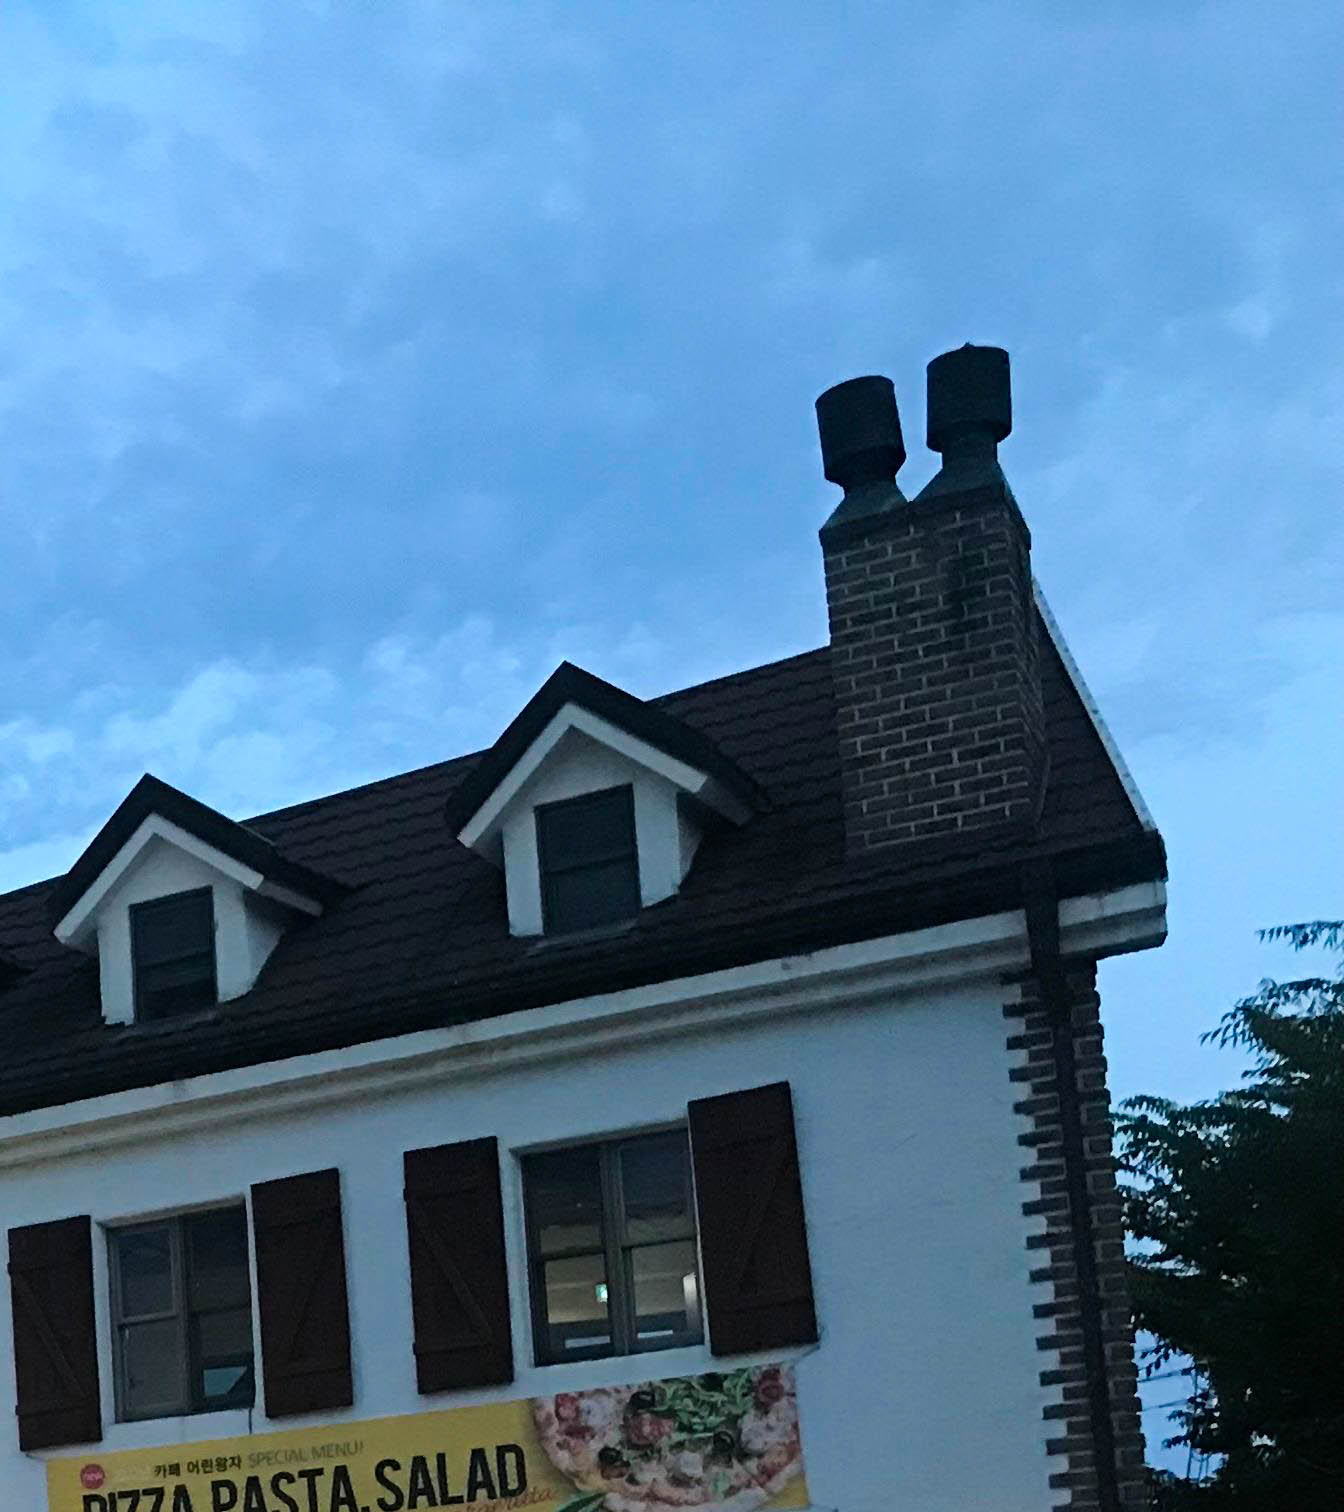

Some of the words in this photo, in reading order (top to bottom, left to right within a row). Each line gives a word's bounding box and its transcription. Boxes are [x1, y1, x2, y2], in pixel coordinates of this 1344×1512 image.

[155, 1462, 181, 1479] 카페
[187, 1455, 242, 1475] 어린왕자
[249, 1449, 305, 1468] SPECIAL
[374, 1443, 528, 1512] SALAD
